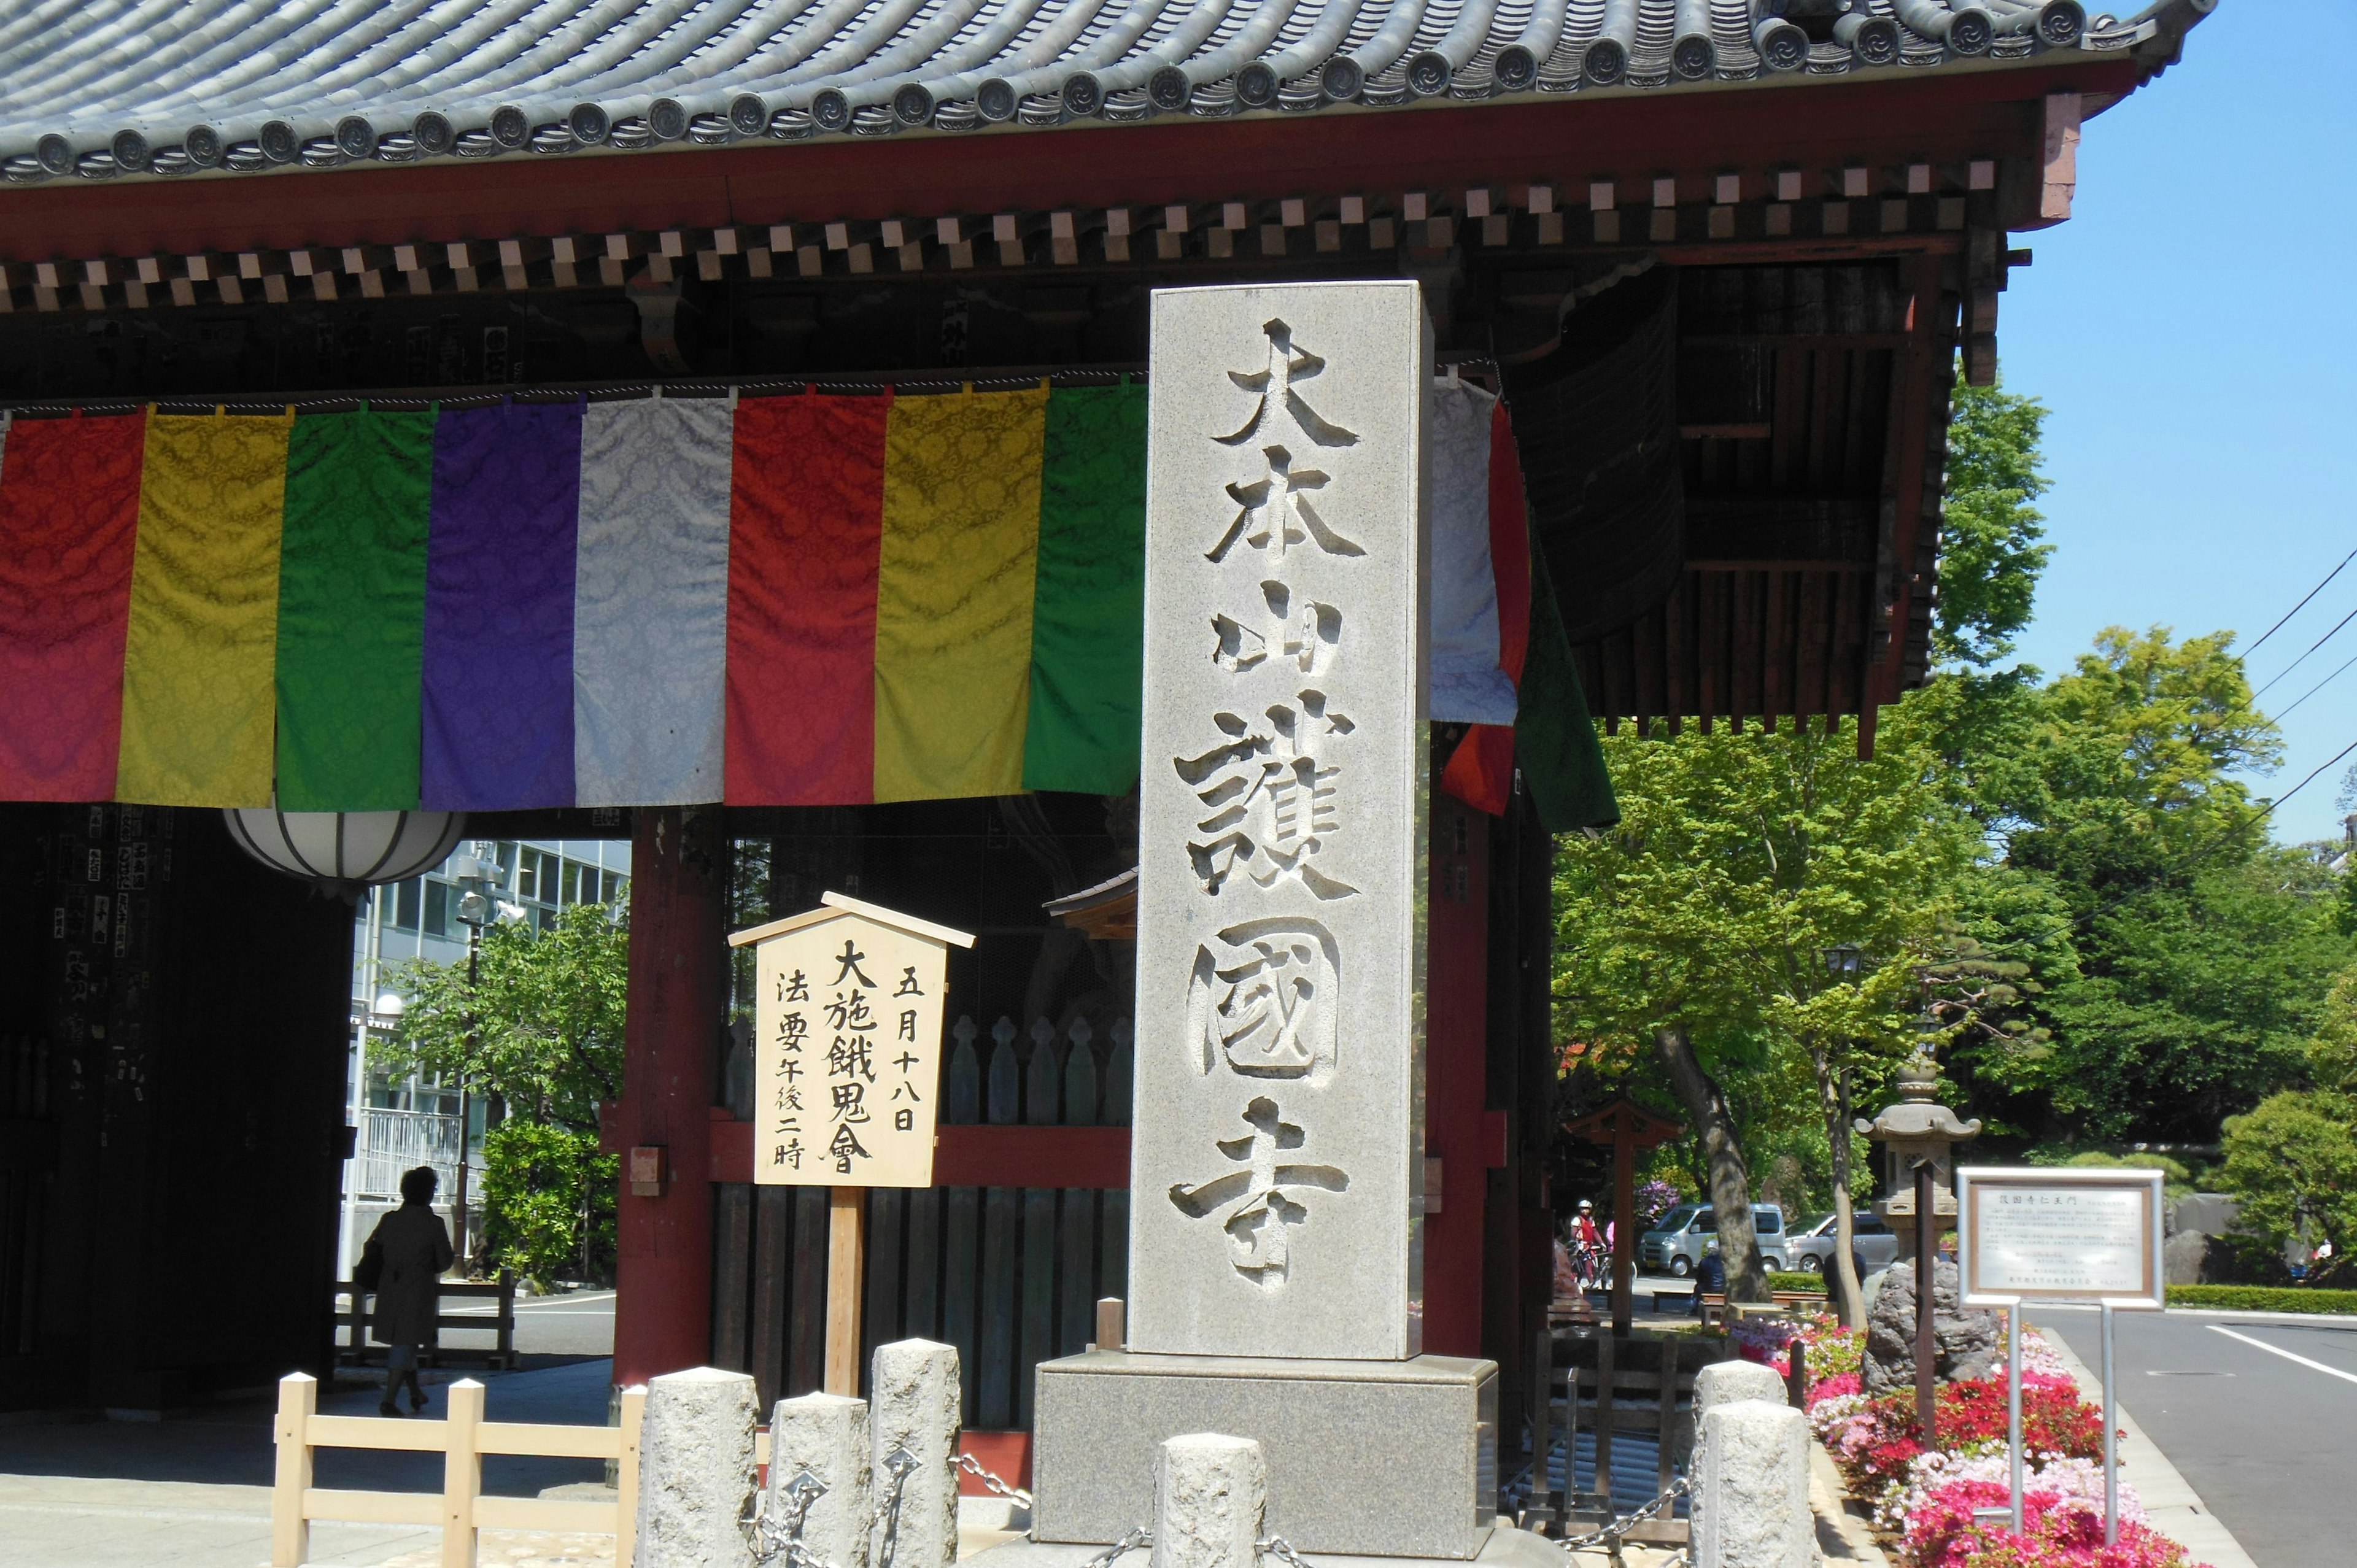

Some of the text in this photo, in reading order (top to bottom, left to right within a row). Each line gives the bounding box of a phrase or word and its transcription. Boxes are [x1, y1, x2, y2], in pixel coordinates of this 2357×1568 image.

[1169, 317, 1368, 1292] 大本山護國寺
[773, 968, 809, 1170] 法要午後二時
[821, 940, 878, 1174] 大施餓鬼會
[891, 966, 925, 1132] 五月十八日
